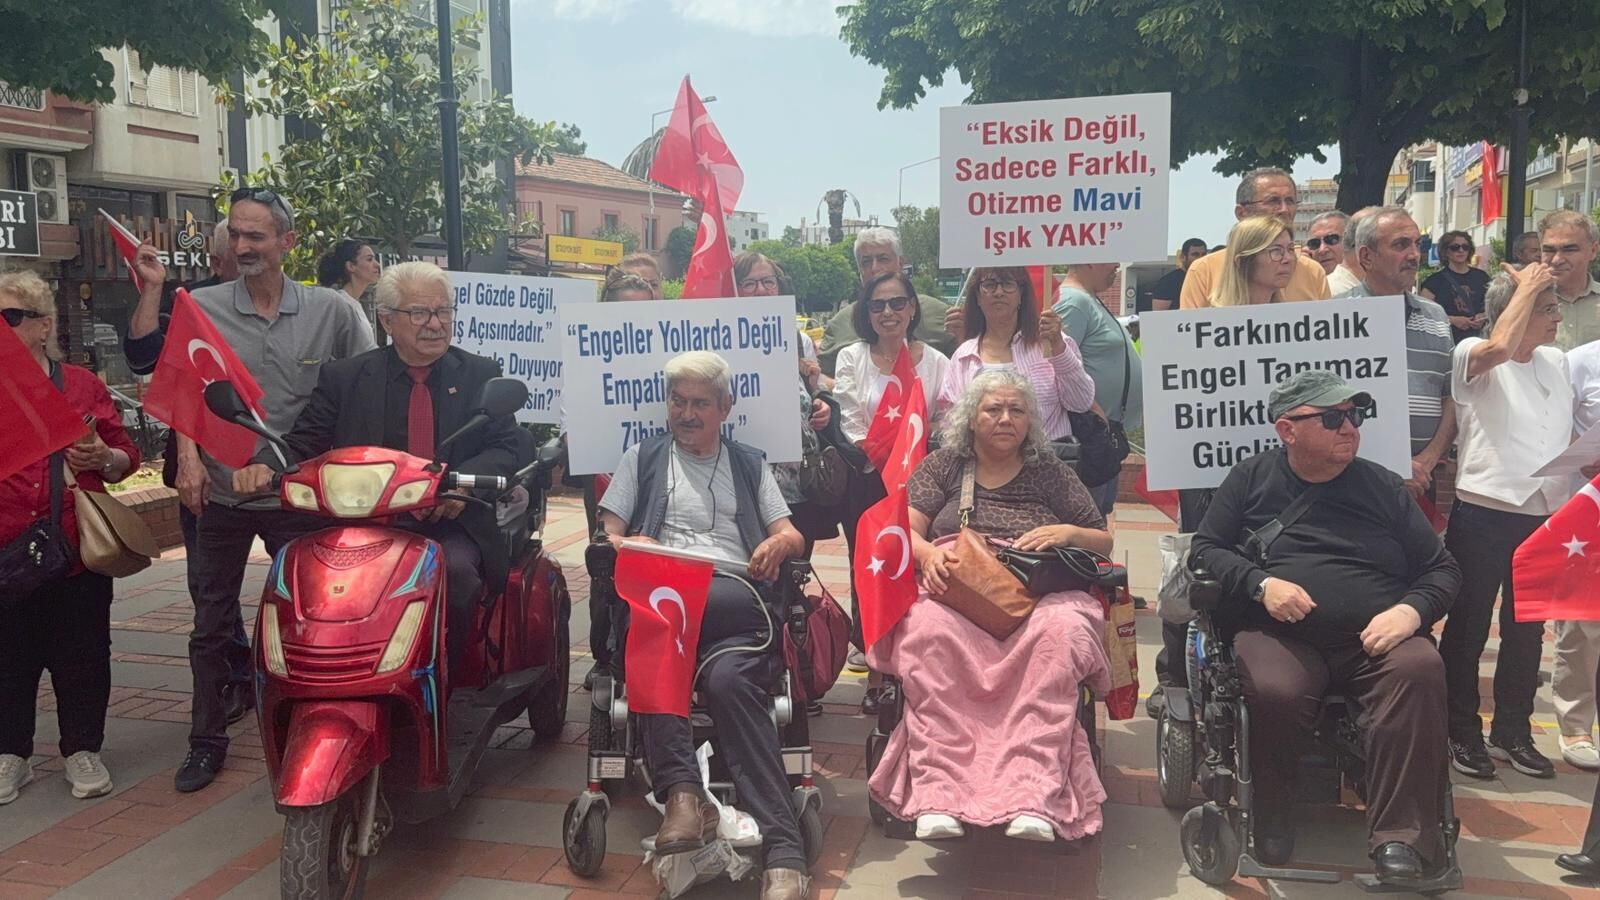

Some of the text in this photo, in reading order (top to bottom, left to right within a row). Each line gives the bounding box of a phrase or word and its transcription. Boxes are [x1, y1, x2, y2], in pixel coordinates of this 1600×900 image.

[967, 114, 1145, 145] “Eksik Değil,
[955, 150, 1156, 182] Sadece Farklı,
[0, 195, 26, 224] Rİ
[968, 187, 1141, 216] Otizme Mavi
[984, 222, 1123, 256] Işık YAK!”
[475, 282, 515, 308] Gözde
[519, 286, 557, 315] Değil,
[467, 316, 553, 346] Açısındadır.”
[567, 315, 788, 363] “Engeller Yollarda Değil,
[1177, 311, 1369, 349] “Farkındalık
[508, 352, 563, 382] Duyuyor
[1161, 359, 1246, 395] Engel
[602, 370, 666, 412] Empati
